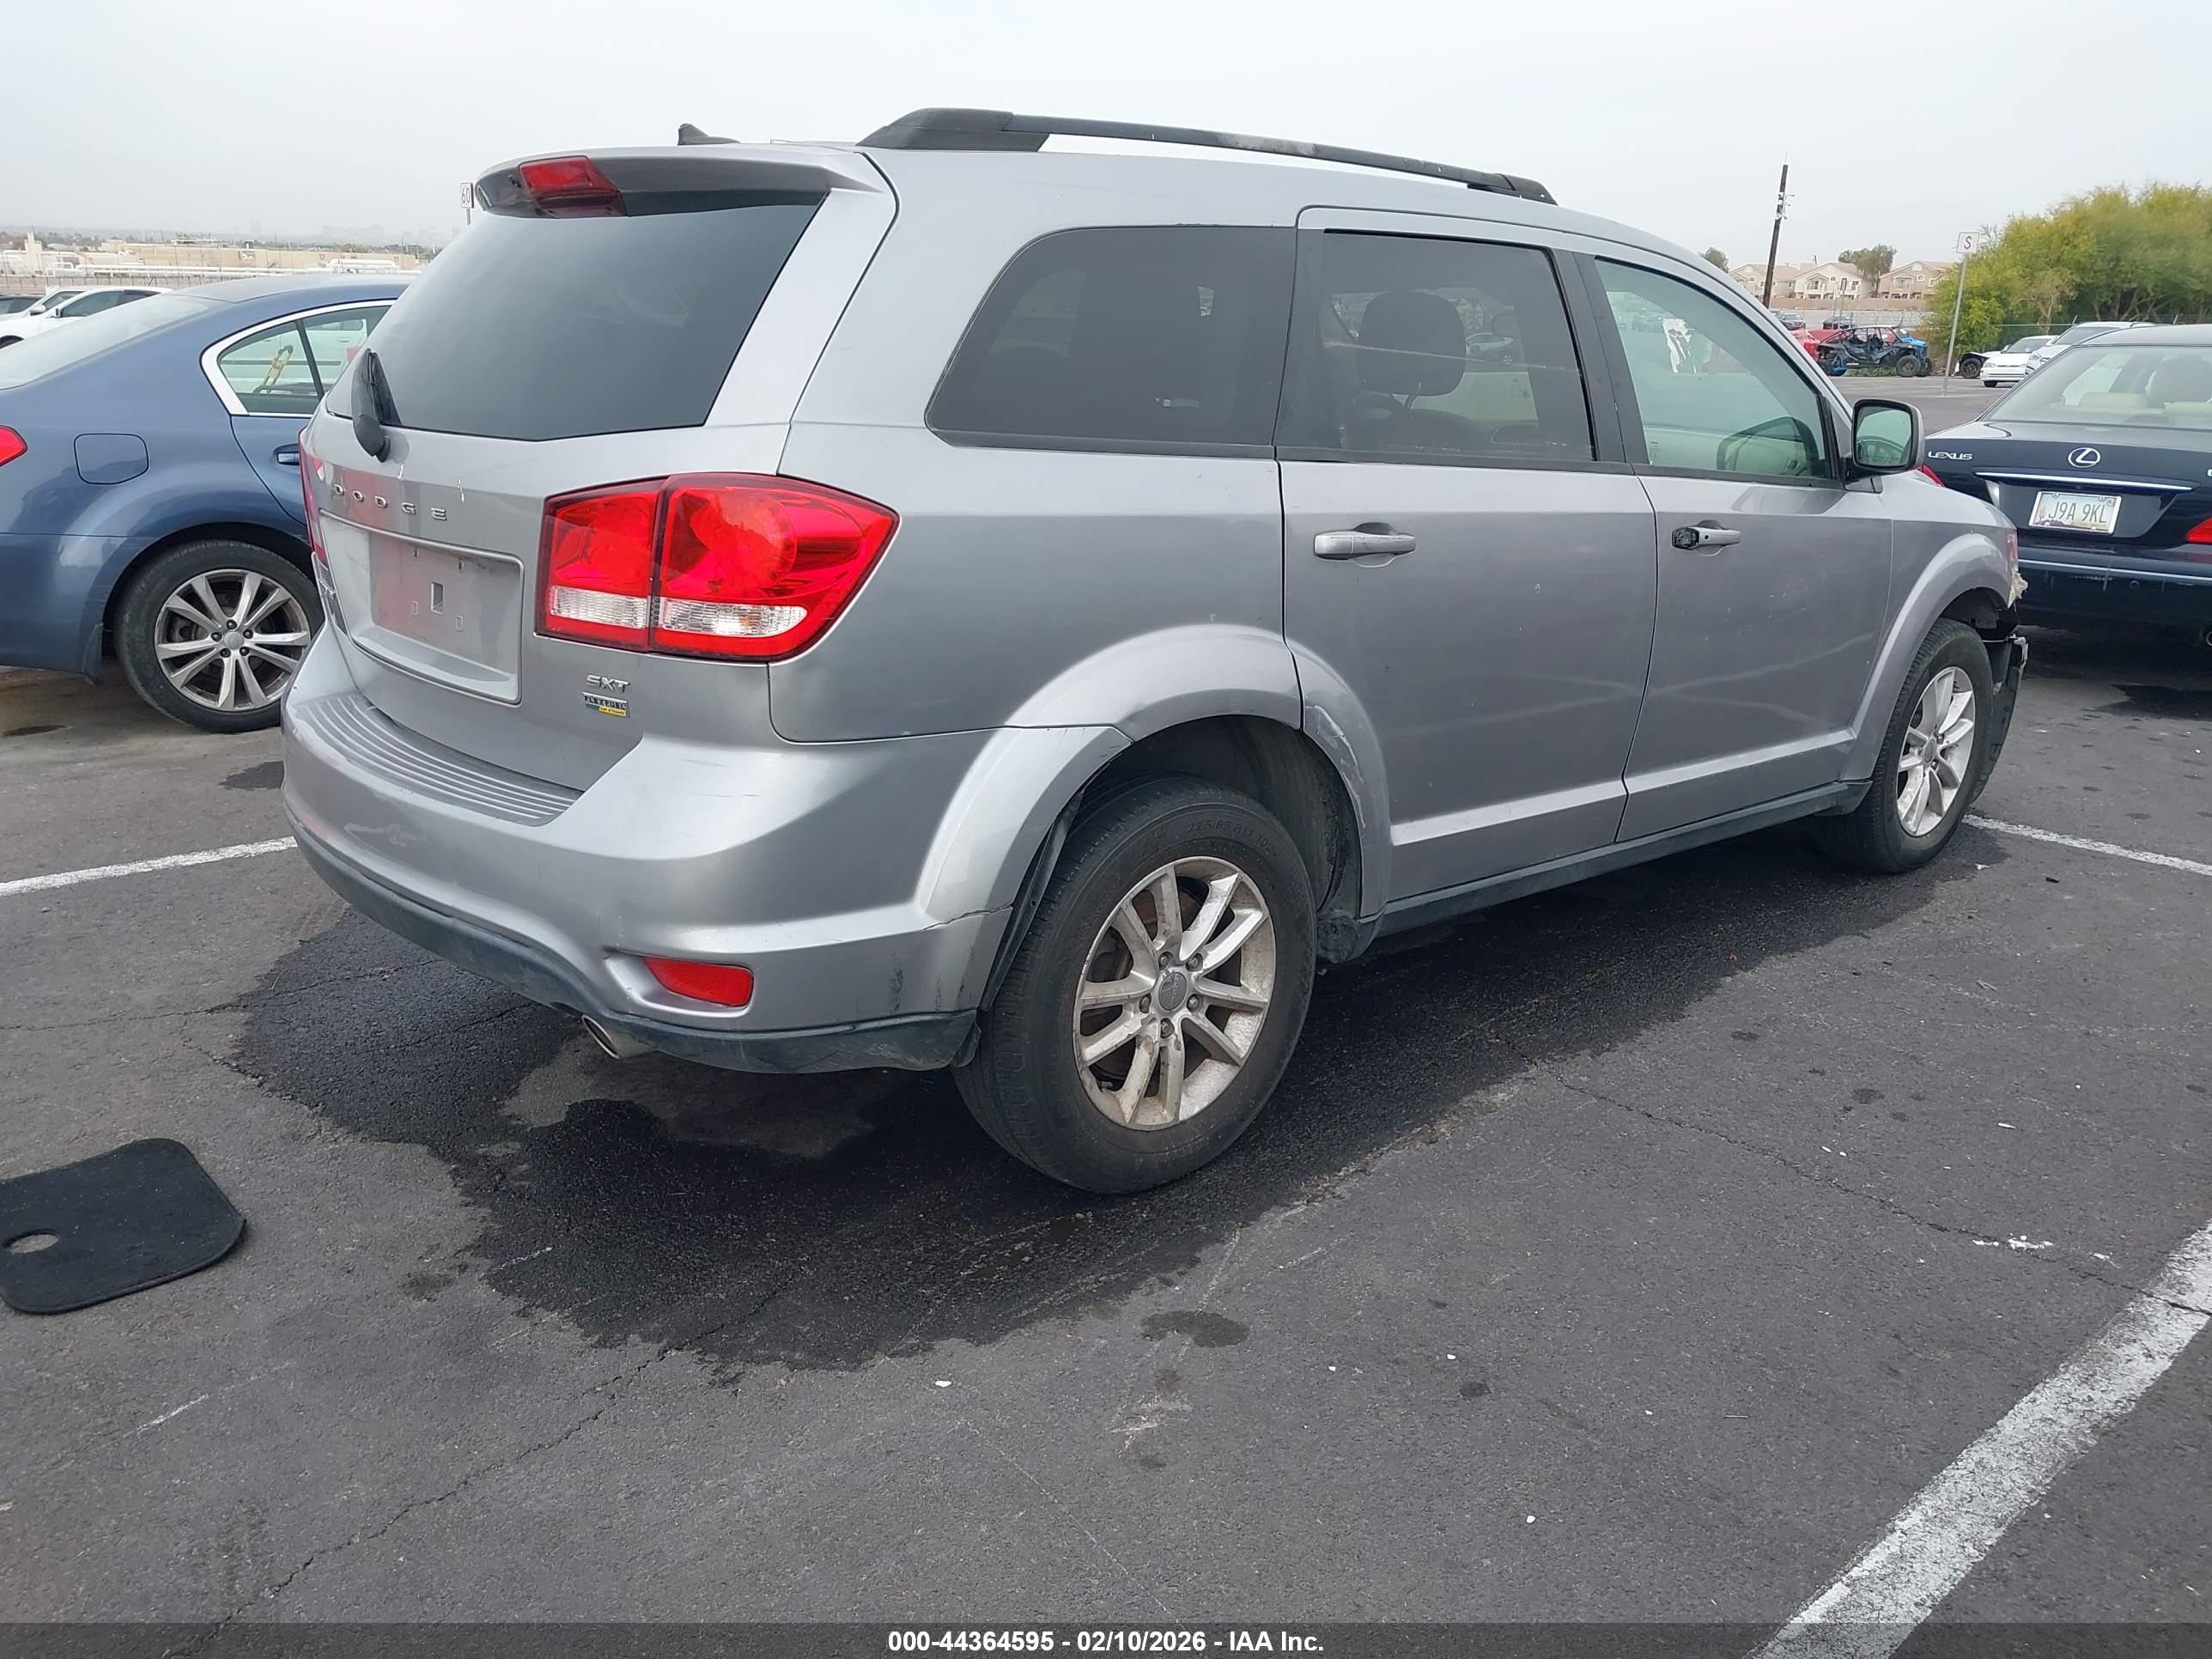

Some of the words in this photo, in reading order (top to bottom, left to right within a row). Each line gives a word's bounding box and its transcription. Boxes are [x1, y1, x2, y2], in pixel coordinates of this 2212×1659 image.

[462, 188, 471, 204] 60
[1964, 235, 1972, 250] S
[1928, 451, 1973, 460] LEXUS
[334, 483, 447, 520] DODGE
[2049, 501, 2076, 520] J9A
[2081, 503, 2107, 523] 9KL
[586, 674, 631, 693] SXT
